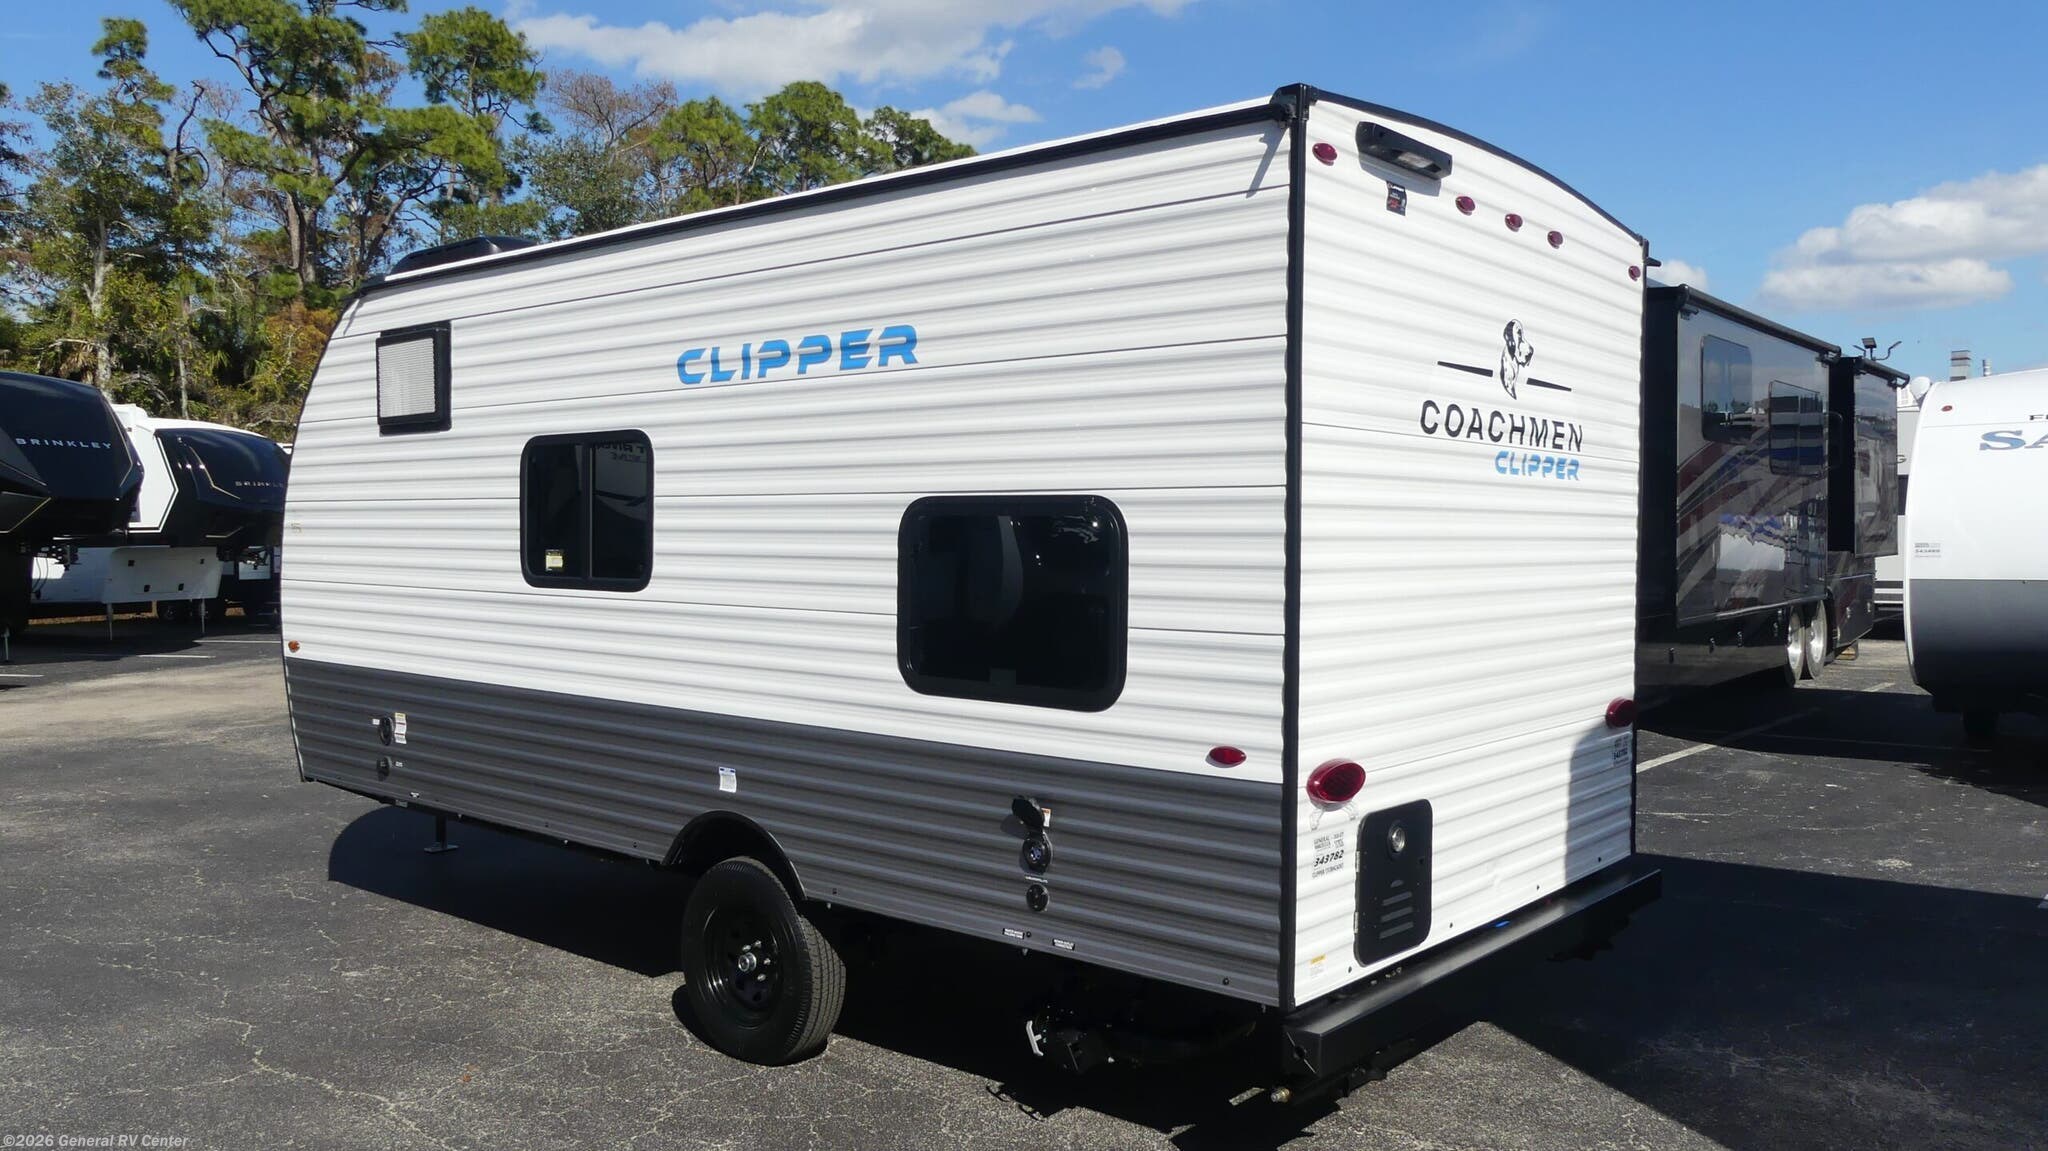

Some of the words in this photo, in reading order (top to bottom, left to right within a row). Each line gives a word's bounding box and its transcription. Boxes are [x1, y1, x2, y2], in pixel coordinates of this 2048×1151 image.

[677, 324, 918, 385] CLIPPER
[1420, 400, 1583, 452] COACHMEN
[15, 438, 112, 449] BRINKLEY
[1495, 451, 1580, 481] CLIPPER
[1313, 849, 1345, 868] 343782
